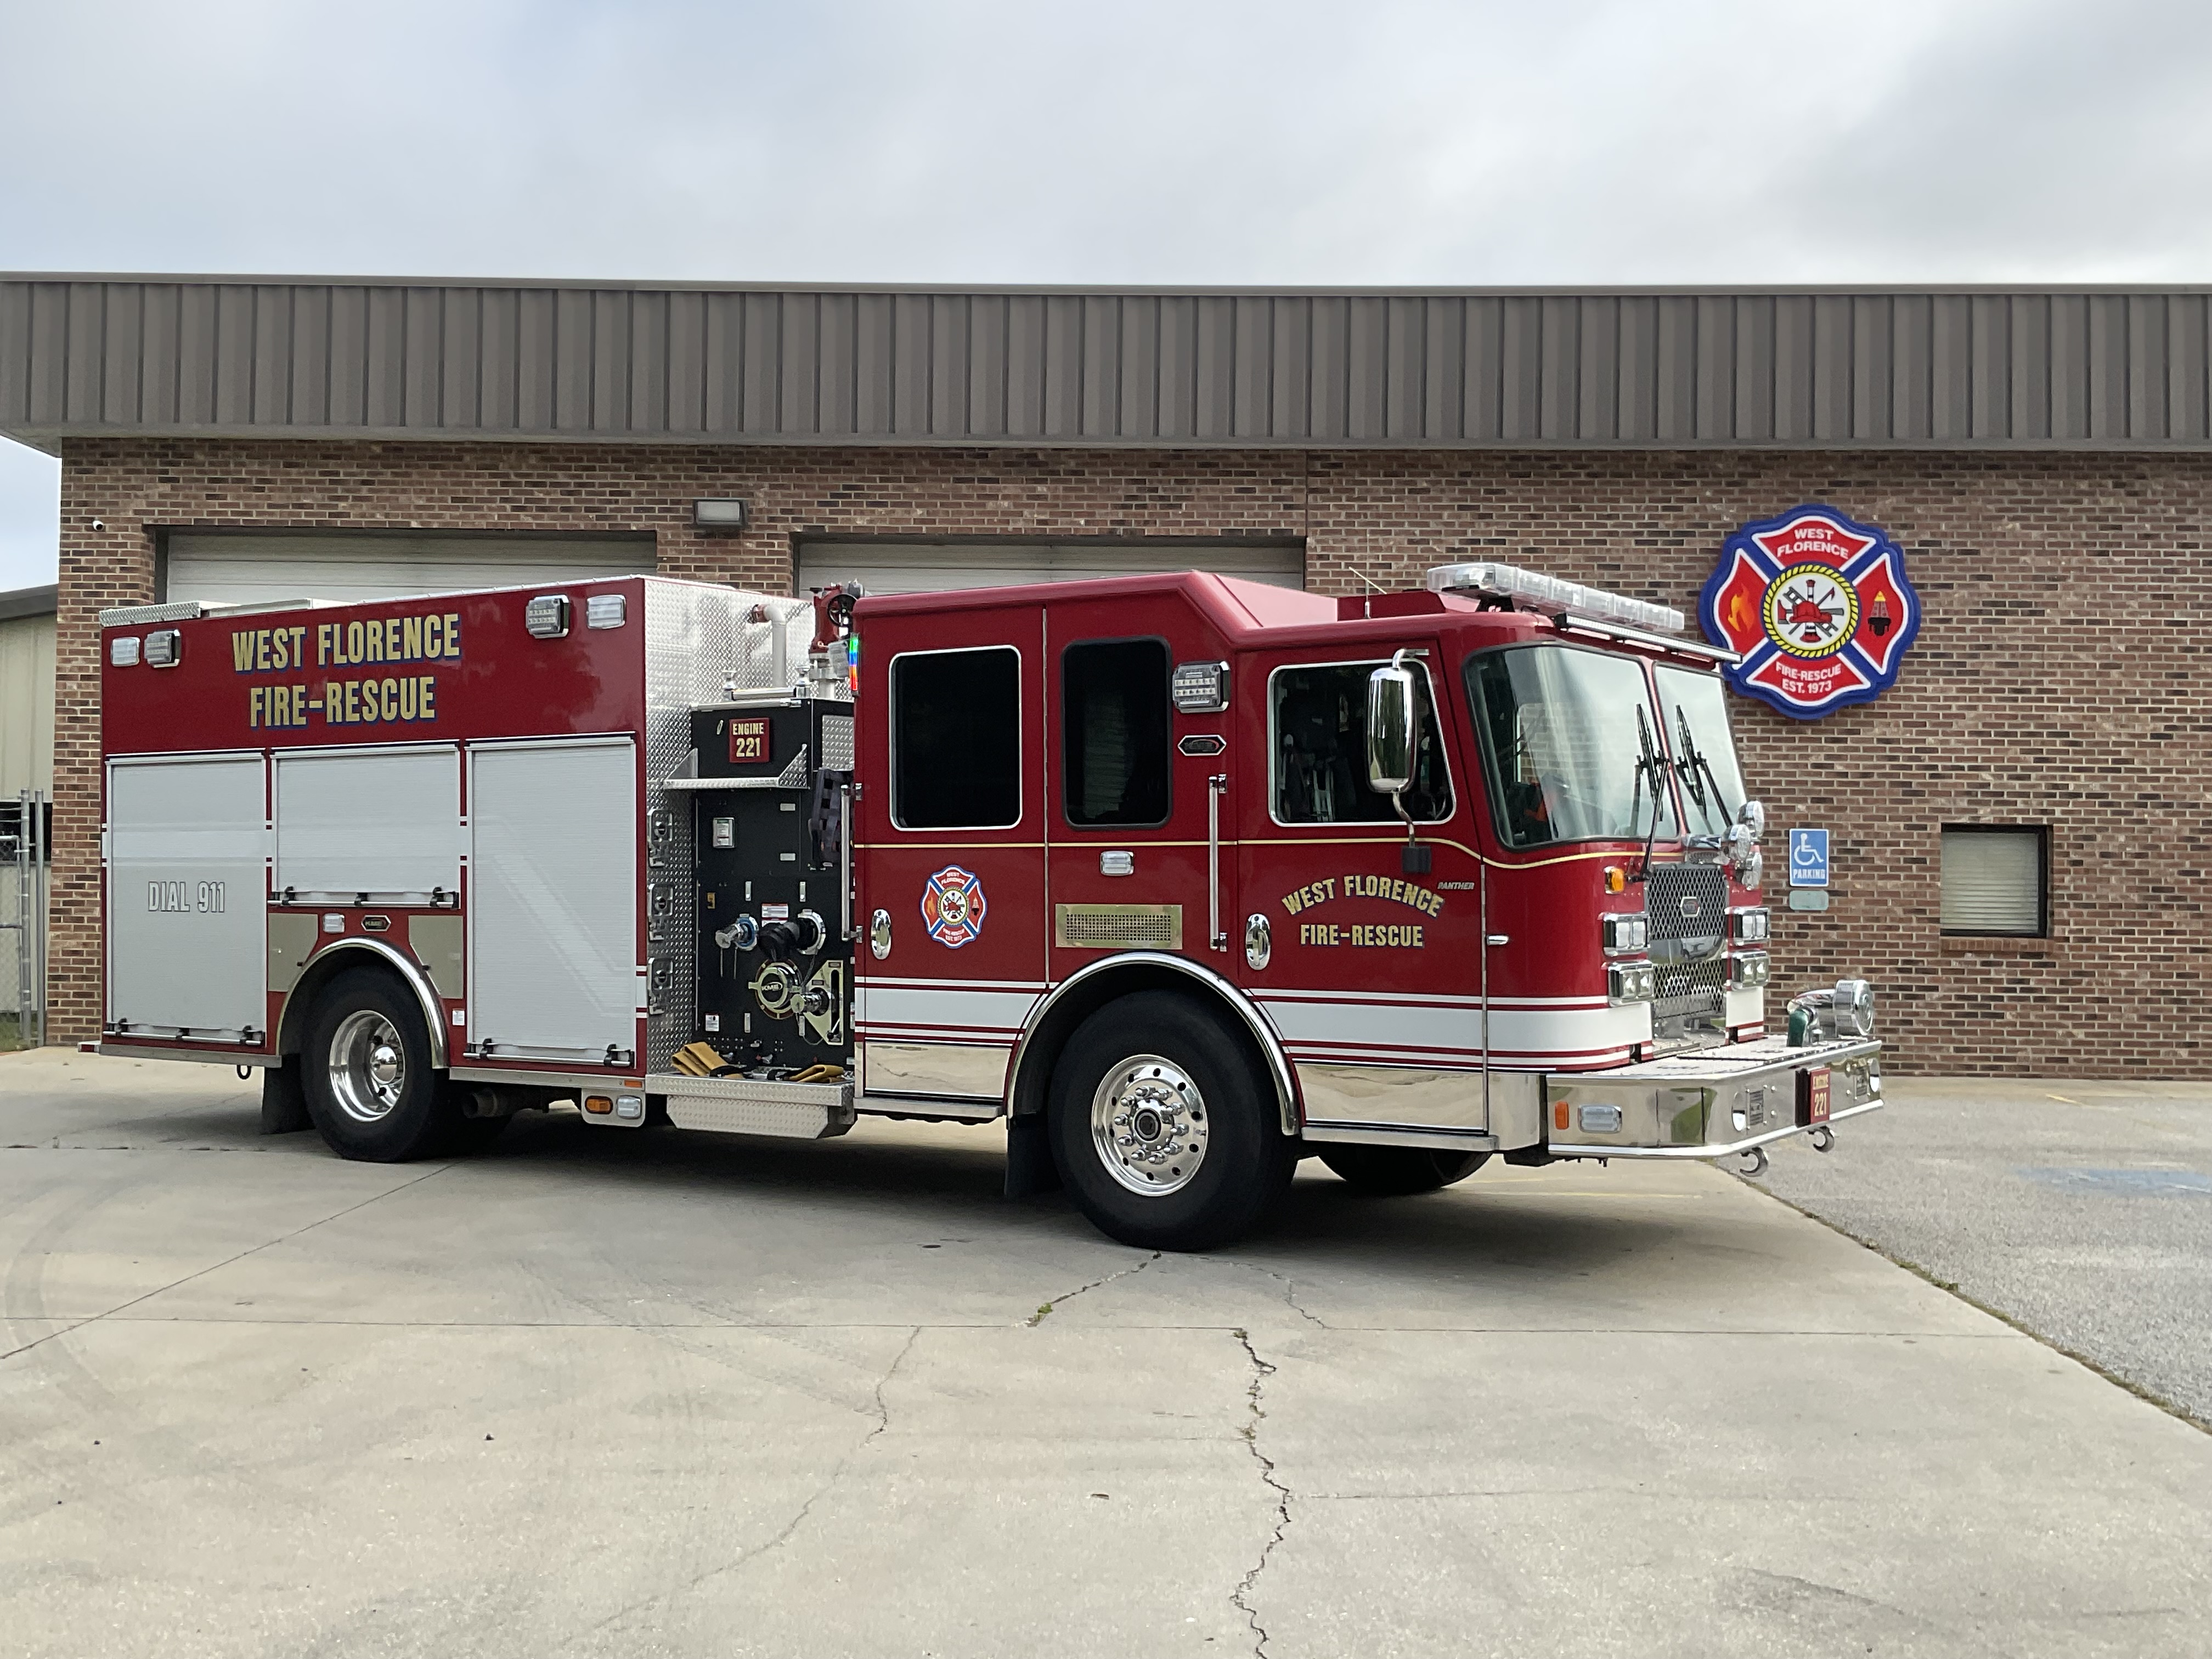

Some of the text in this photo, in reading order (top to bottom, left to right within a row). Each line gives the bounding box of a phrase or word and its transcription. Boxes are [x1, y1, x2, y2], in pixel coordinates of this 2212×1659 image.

[1795, 528, 1833, 540] WEST
[1777, 541, 1849, 560] FLORENCE
[232, 613, 460, 672] WEST FLORENCE
[1775, 661, 1842, 681] FIRE-RESCUE
[1782, 680, 1832, 693] EST. 1973
[251, 676, 437, 728] FIRE-RESCUE
[732, 723, 764, 736] ENGINE
[736, 737, 760, 758] 221
[1793, 868, 1825, 879] PARKING
[1282, 874, 1445, 918] WEST FLORENCE
[1437, 882, 1475, 890] PANTHER
[148, 881, 225, 913] DIAL 911
[1300, 924, 1424, 947] FIRE-RESCUE
[1814, 1092, 1827, 1116] 221
